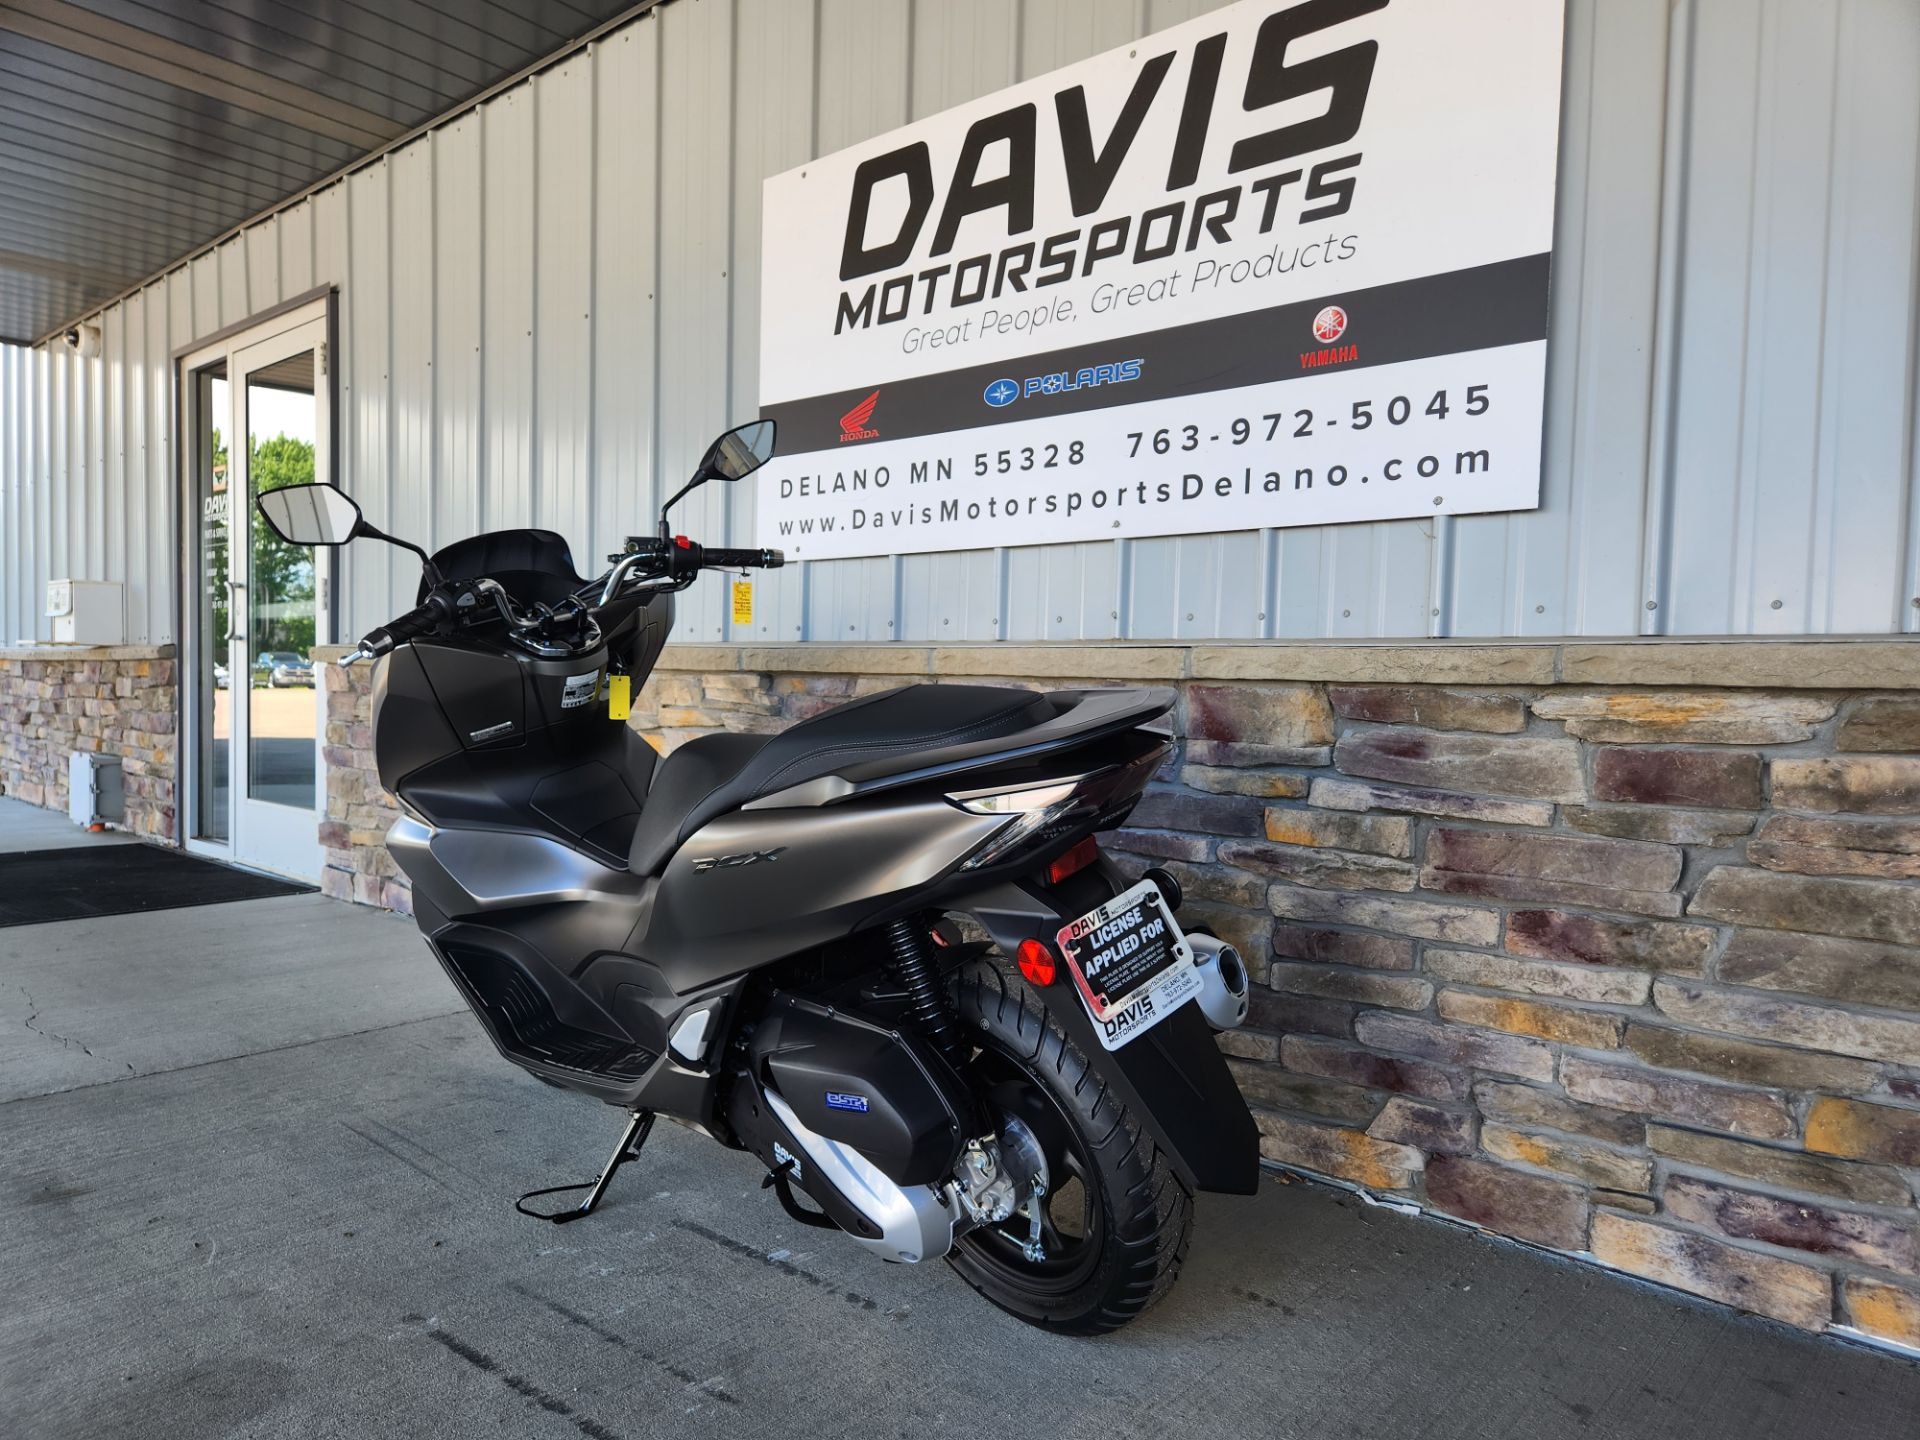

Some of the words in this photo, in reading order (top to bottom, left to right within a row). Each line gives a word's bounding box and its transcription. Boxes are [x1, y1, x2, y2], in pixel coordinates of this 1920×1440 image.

[839, 0, 1391, 282] DAVIS
[834, 152, 1363, 335] MOTORSPORTS
[902, 318, 972, 354] Great
[980, 295, 1077, 338] People,
[1091, 269, 1181, 313] Great
[1192, 233, 1358, 292] Products
[1300, 343, 1358, 369] YAMAHA
[1024, 359, 1141, 398] POLARIS
[780, 466, 890, 498] DELANO
[910, 457, 952, 484] MN
[974, 440, 1085, 476] 55328
[1127, 384, 1490, 459] 763-972-5045
[839, 429, 881, 442] HONDA
[779, 448, 1490, 536] www.DavisMotorsportsDelano.com
[1071, 906, 1110, 938] DAVIS
[1090, 907, 1143, 950] LICENSE
[1086, 934, 1139, 978] APPLIED
[1139, 918, 1164, 943] FOR
[1104, 995, 1153, 1038] DAVIS
[1108, 1010, 1156, 1044] MOTORSPORTS
